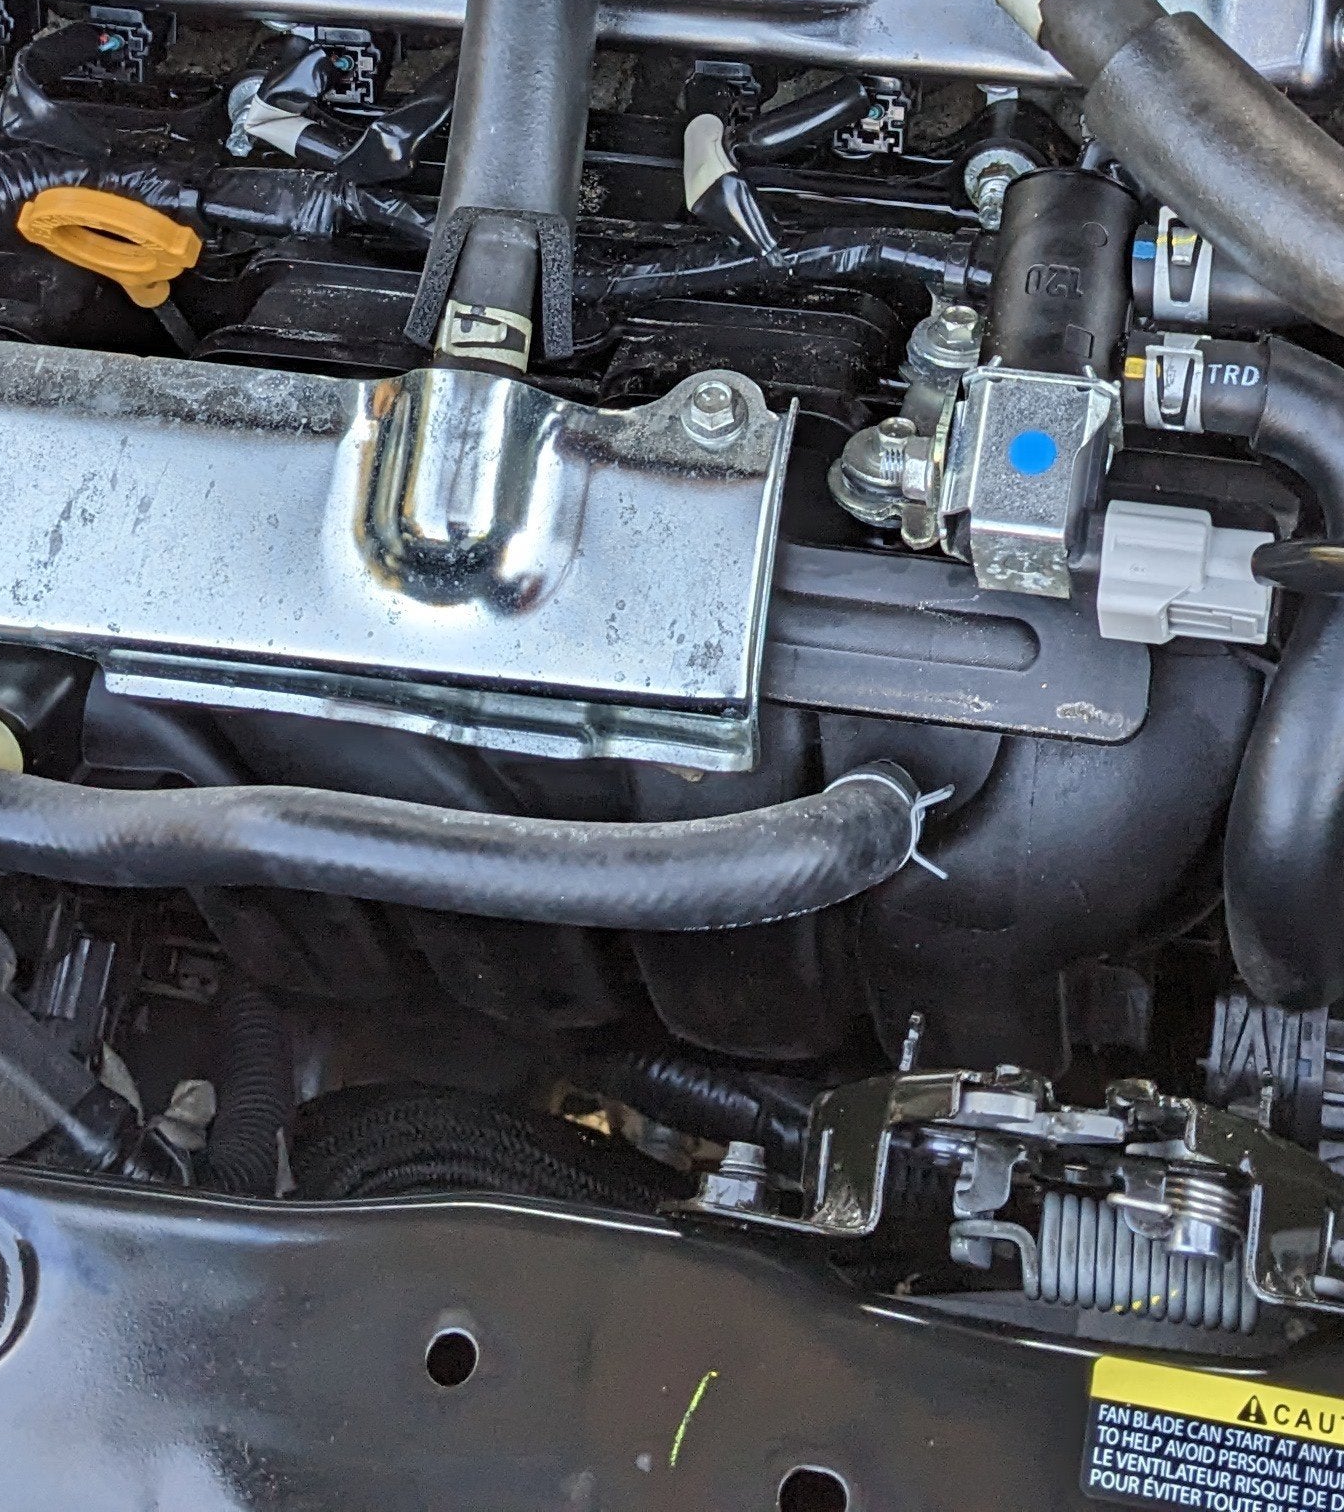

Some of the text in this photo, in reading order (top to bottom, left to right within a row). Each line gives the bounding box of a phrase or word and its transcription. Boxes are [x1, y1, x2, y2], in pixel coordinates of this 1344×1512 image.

[1207, 362, 1261, 389] TRD
[1097, 1403, 1131, 1425] FAN
[1133, 1410, 1185, 1437] BLADE
[1187, 1420, 1223, 1445] CAN
[1224, 1427, 1274, 1454] START
[1275, 1438, 1296, 1458] AT
[1297, 1442, 1334, 1465] ANY
[1097, 1424, 1119, 1445] TO
[1121, 1429, 1162, 1454] HELP
[1162, 1437, 1215, 1466] AVOID
[1217, 1448, 1301, 1482] PERSONAL
[1089, 1468, 1263, 1512] POUR ÉVITER TOUTE
[1092, 1446, 1114, 1467] LE
[1115, 1453, 1231, 1492] VENTILATEUR
[1234, 1477, 1299, 1504] RISQUE
[1302, 1487, 1327, 1508] DE
